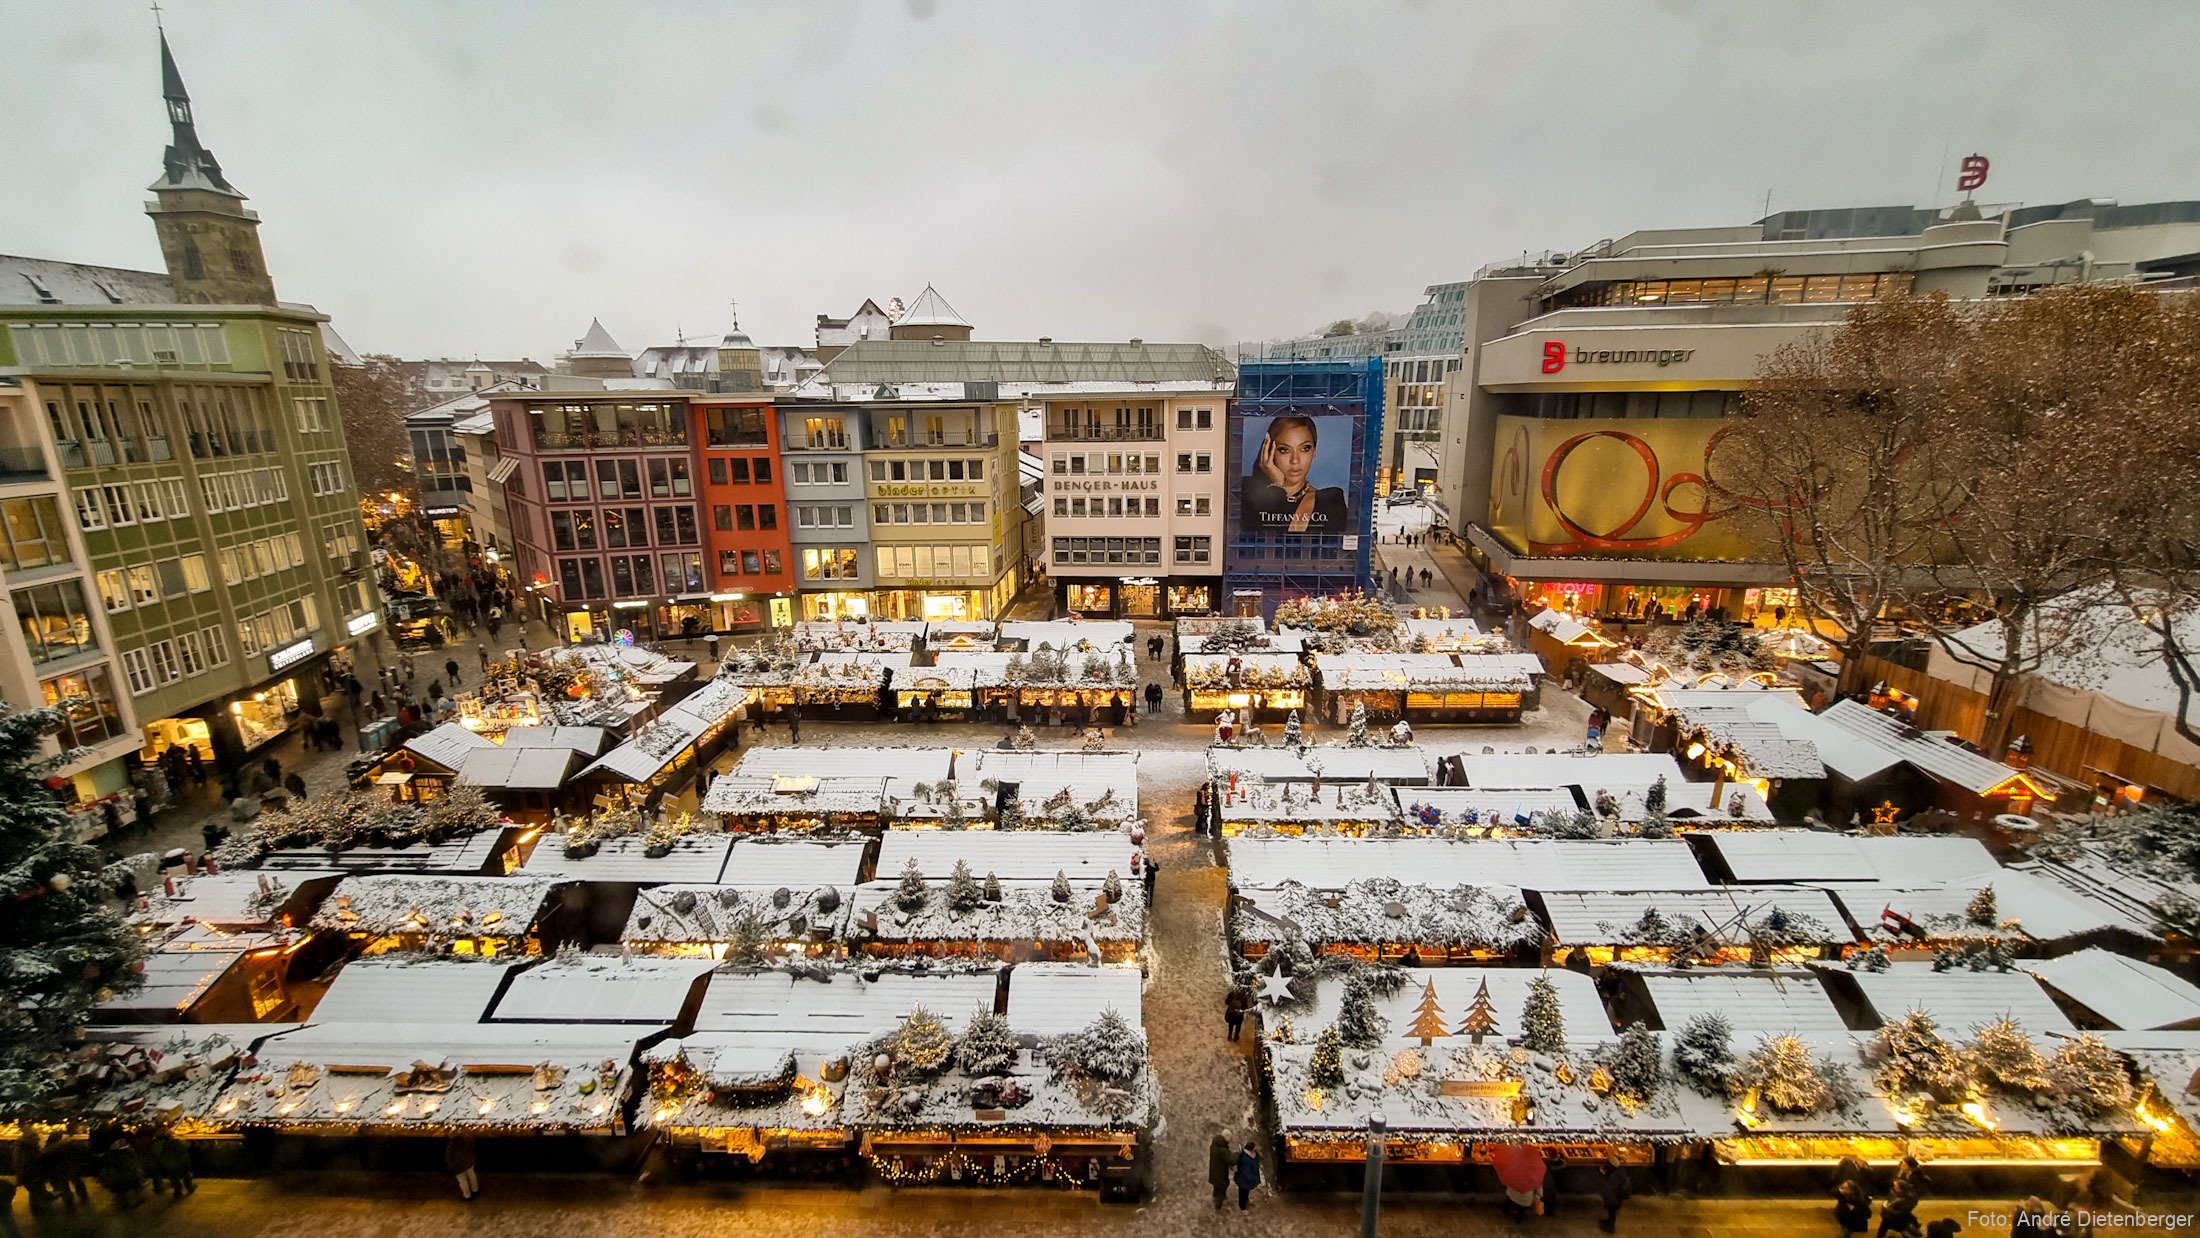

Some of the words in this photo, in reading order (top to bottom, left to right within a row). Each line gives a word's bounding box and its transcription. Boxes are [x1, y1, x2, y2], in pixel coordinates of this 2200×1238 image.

[1576, 347, 1696, 368] breuninger
[878, 485, 925, 496] binder
[1054, 480, 1158, 493] BENGER-HAUS
[1259, 511, 1300, 522] TIFFANY
